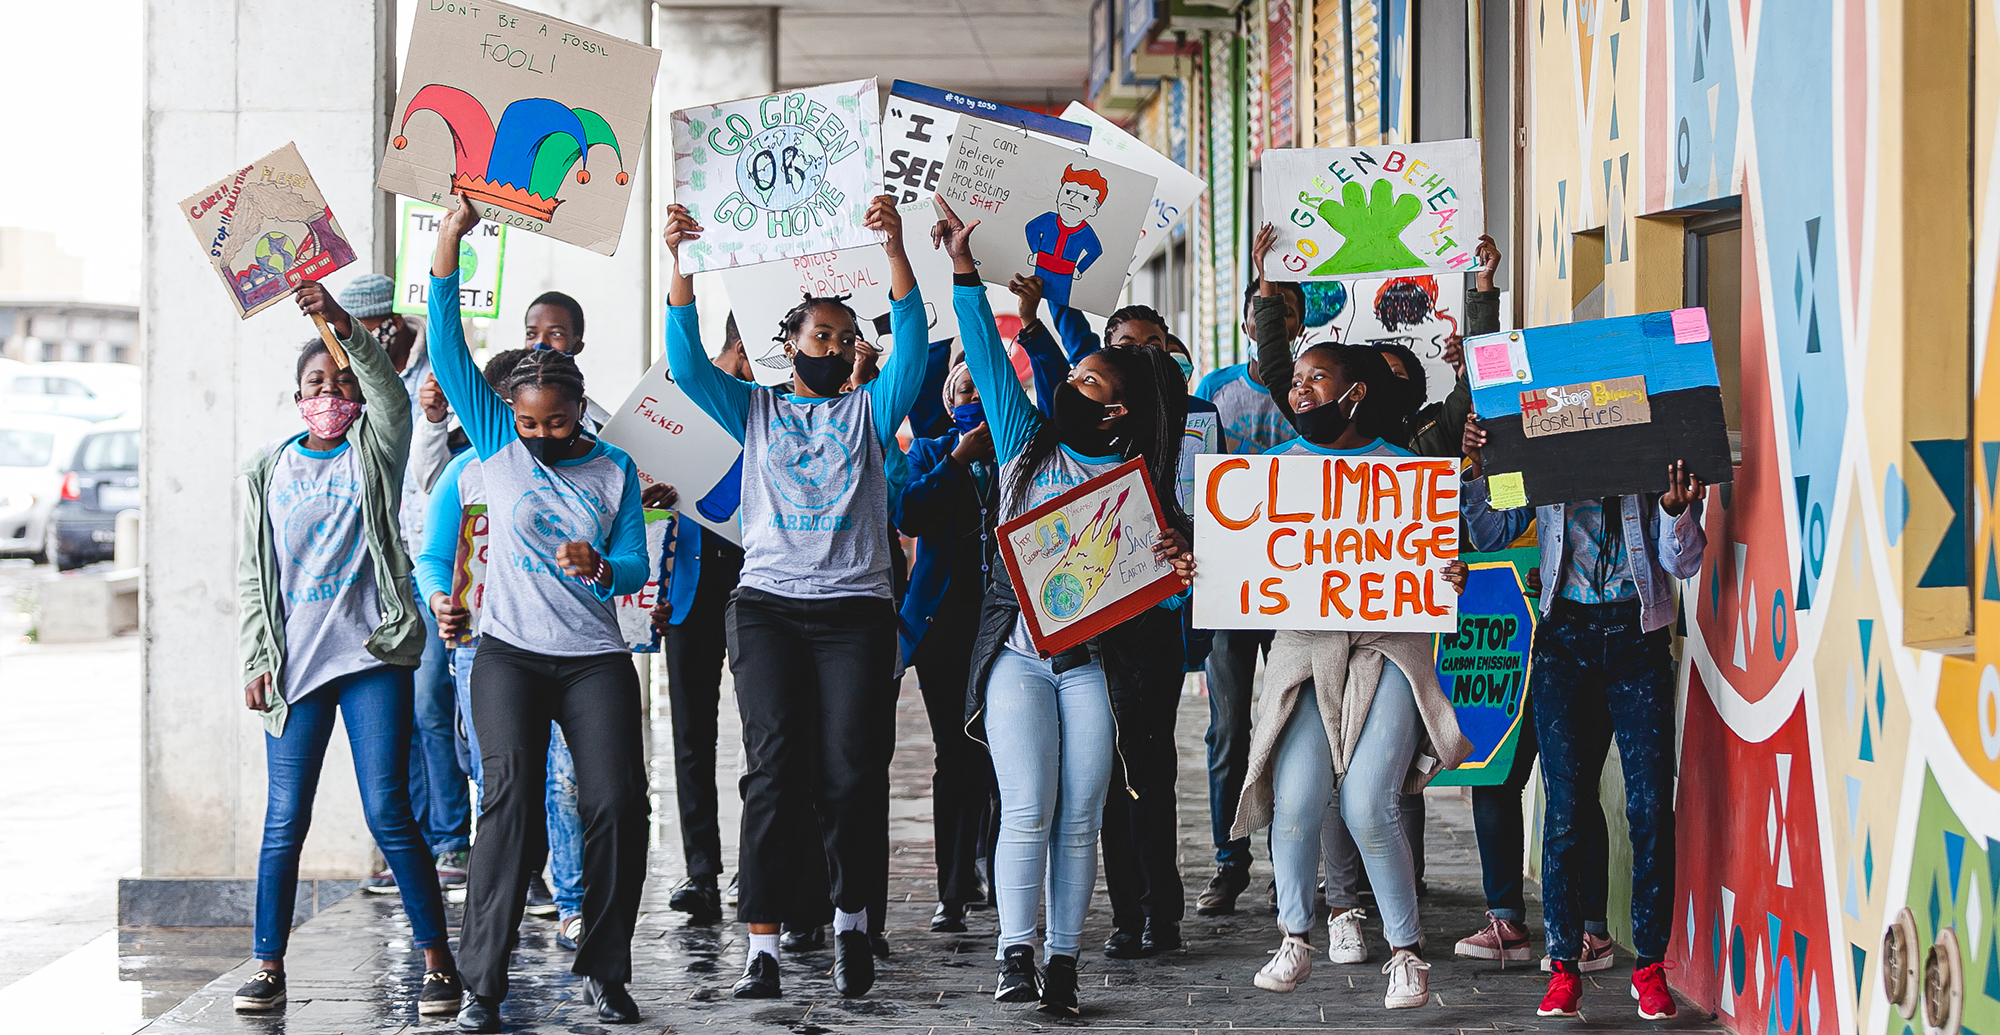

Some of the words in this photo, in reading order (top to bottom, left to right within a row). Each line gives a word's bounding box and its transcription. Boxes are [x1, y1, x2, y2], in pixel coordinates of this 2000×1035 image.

[498, 14, 519, 29] BE
[538, 24, 548, 36] A
[562, 33, 609, 57] FOSSIL
[966, 98, 976, 109] by
[977, 100, 997, 111] 2030
[708, 114, 753, 155] GO
[760, 92, 859, 165] GREEN
[962, 124, 982, 142] I
[752, 145, 806, 190] OR
[959, 141, 1004, 168] believe
[973, 164, 995, 180] still
[713, 190, 758, 231] GO
[767, 181, 846, 238] HOME
[946, 186, 967, 202] this
[969, 194, 1004, 214] SH#T
[482, 207, 501, 219] BY
[505, 214, 544, 232] 2030
[483, 224, 500, 237] NO
[1282, 239, 1319, 272] GO
[800, 267, 879, 301] SURVIVAL
[802, 271, 814, 281] it
[823, 265, 835, 277] is
[1206, 457, 1459, 531] CLIMATE
[1124, 525, 1157, 556] SAVE
[1267, 522, 1459, 571] CHANGE
[1118, 560, 1148, 585] EARTH
[1240, 577, 1290, 615] IS
[1320, 569, 1453, 621] REAL
[1441, 657, 1475, 671] CARBON
[1477, 655, 1520, 671] EMISSION
[1453, 671, 1522, 715] NOW!
